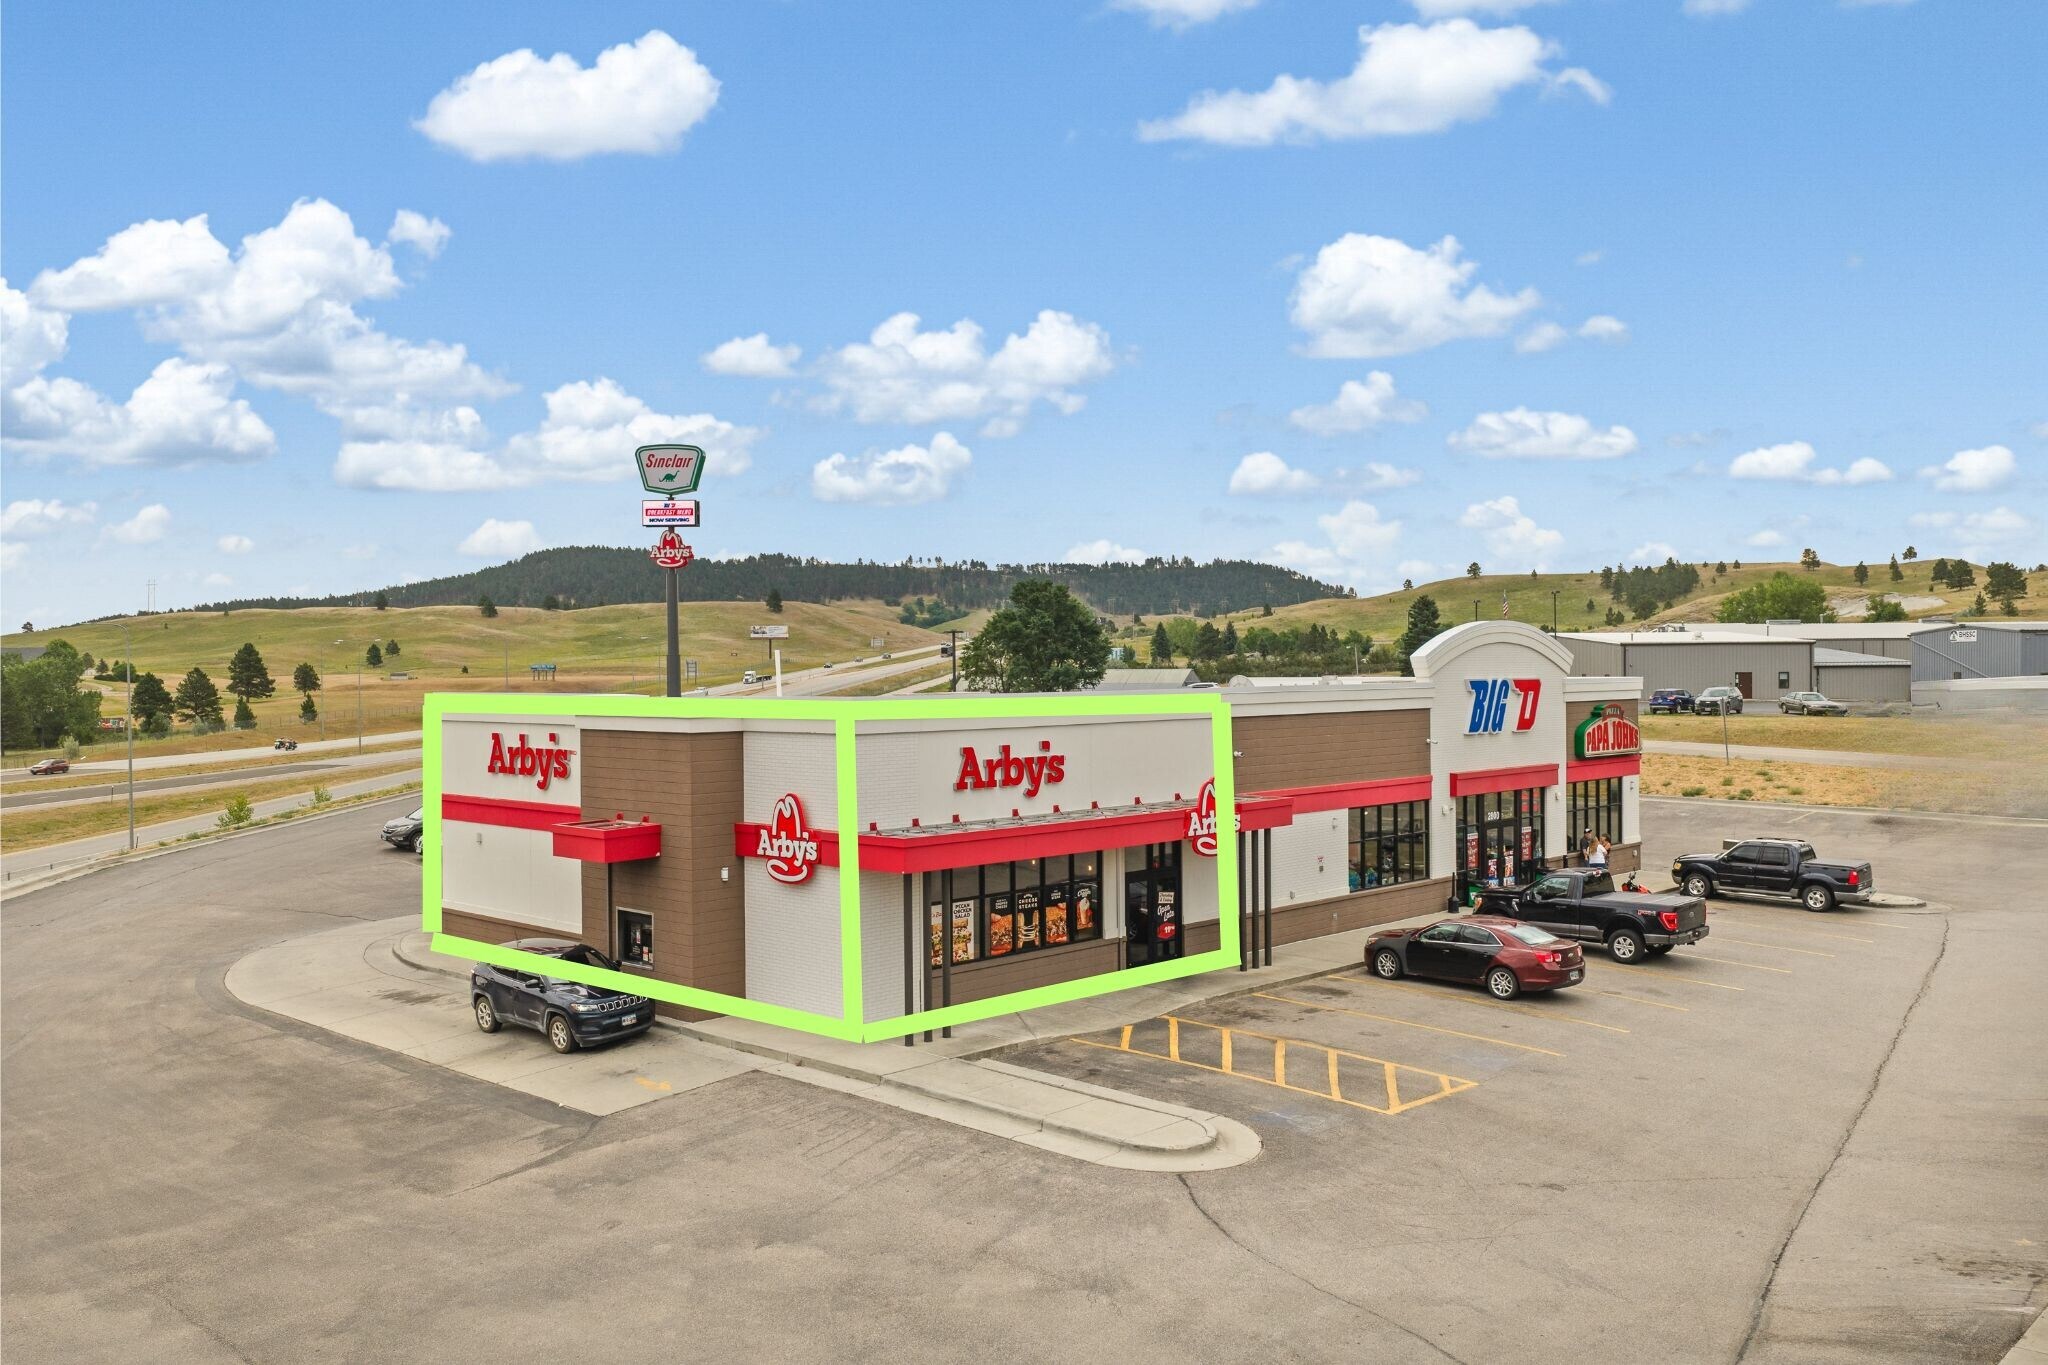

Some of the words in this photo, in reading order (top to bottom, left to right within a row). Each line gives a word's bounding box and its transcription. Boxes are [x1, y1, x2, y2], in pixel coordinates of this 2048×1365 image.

[645, 453, 693, 468] Sinclair
[650, 545, 690, 560] Arby's
[1465, 679, 1510, 735] BIG
[1512, 679, 1541, 733] D
[1586, 721, 1609, 753] PAPA
[488, 732, 571, 790] Arby's
[953, 740, 1066, 798] Arby's
[757, 829, 817, 867] Arby's
